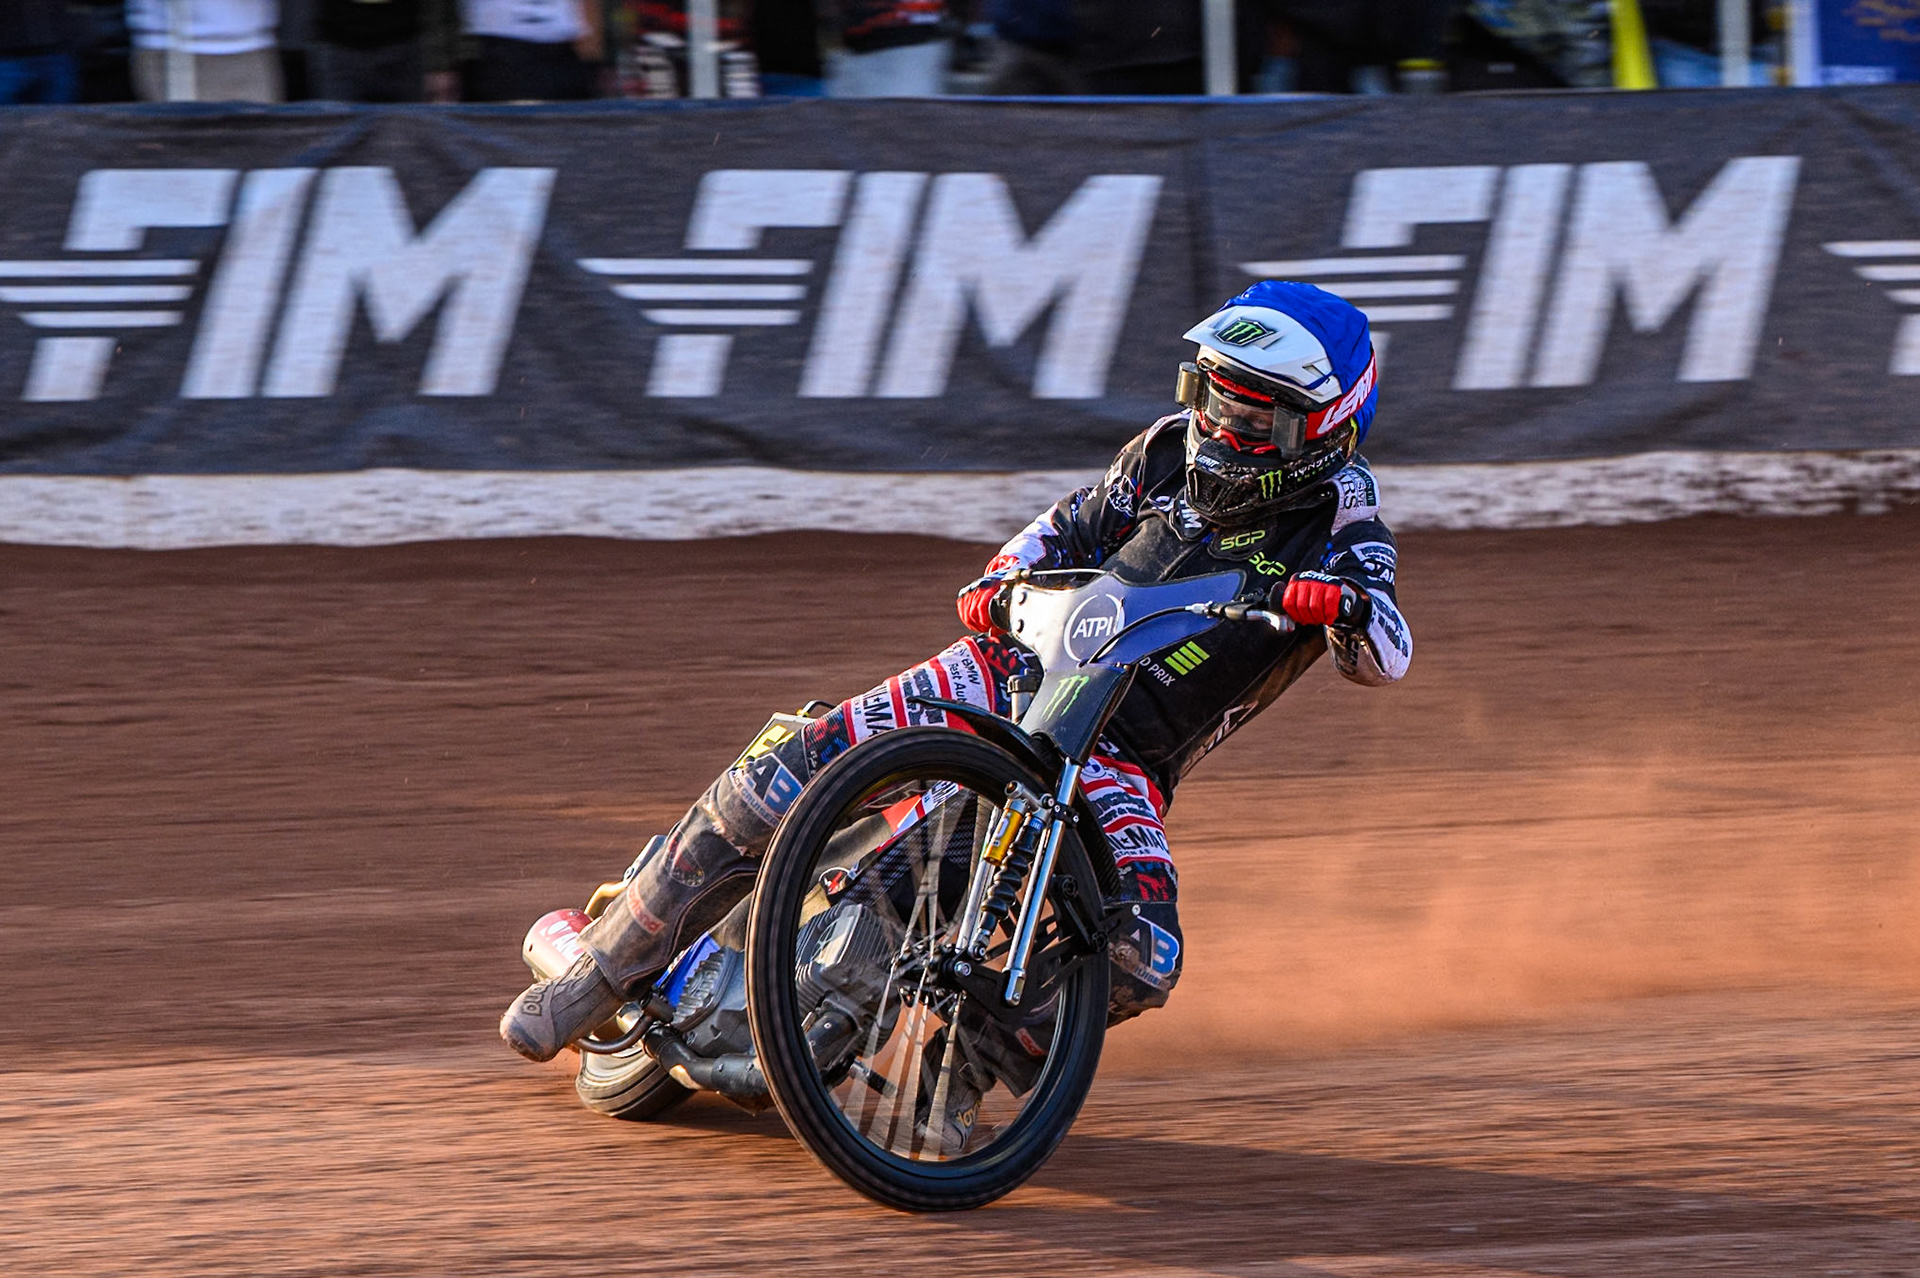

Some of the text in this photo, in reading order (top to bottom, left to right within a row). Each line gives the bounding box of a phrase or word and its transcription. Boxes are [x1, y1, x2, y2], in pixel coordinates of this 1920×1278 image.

[0, 167, 558, 402] FIM
[576, 168, 1164, 399] FIM
[1243, 155, 1802, 392] FIM
[1220, 529, 1265, 551] SGP
[1072, 616, 1113, 639] ATPI
[1148, 664, 1176, 687] PRIX
